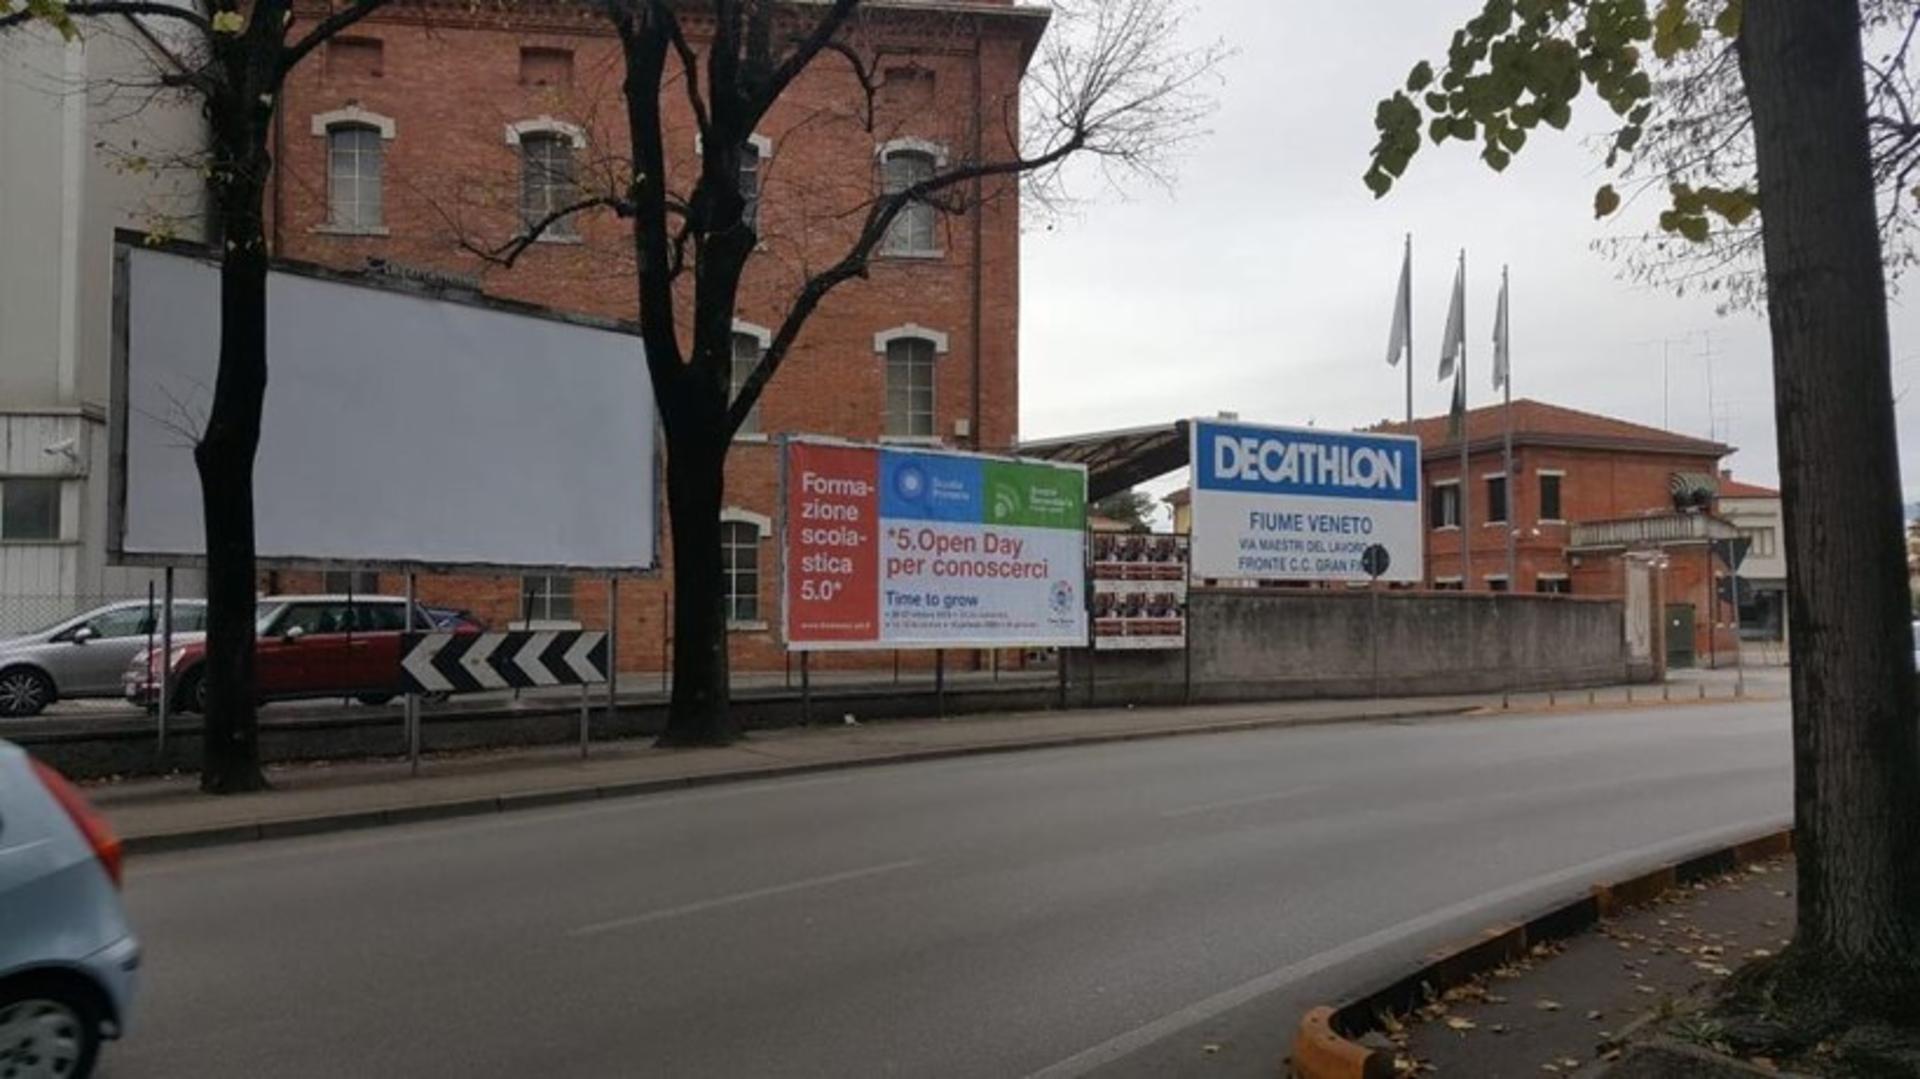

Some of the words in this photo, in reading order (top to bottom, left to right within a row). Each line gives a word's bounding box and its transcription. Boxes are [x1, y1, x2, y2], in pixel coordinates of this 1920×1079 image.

[1214, 435, 1401, 490] DECATHLON
[802, 472, 875, 497] Forma-
[802, 499, 859, 521] zione
[1250, 511, 1304, 532] FIUME
[1307, 514, 1373, 534] VENETO
[802, 526, 867, 547] scola-
[983, 532, 1024, 557] Day
[1239, 538, 1257, 551] VIA
[1259, 538, 1305, 552] MAESTRI
[1307, 540, 1326, 552] DEL
[802, 553, 853, 573] stica
[886, 556, 926, 578] per
[932, 558, 1049, 579] conoscerci
[1238, 556, 1286, 571] FRONTE
[1315, 558, 1347, 572] GRAN
[886, 591, 920, 606] Time
[926, 592, 940, 606] to
[943, 594, 979, 608] grow
